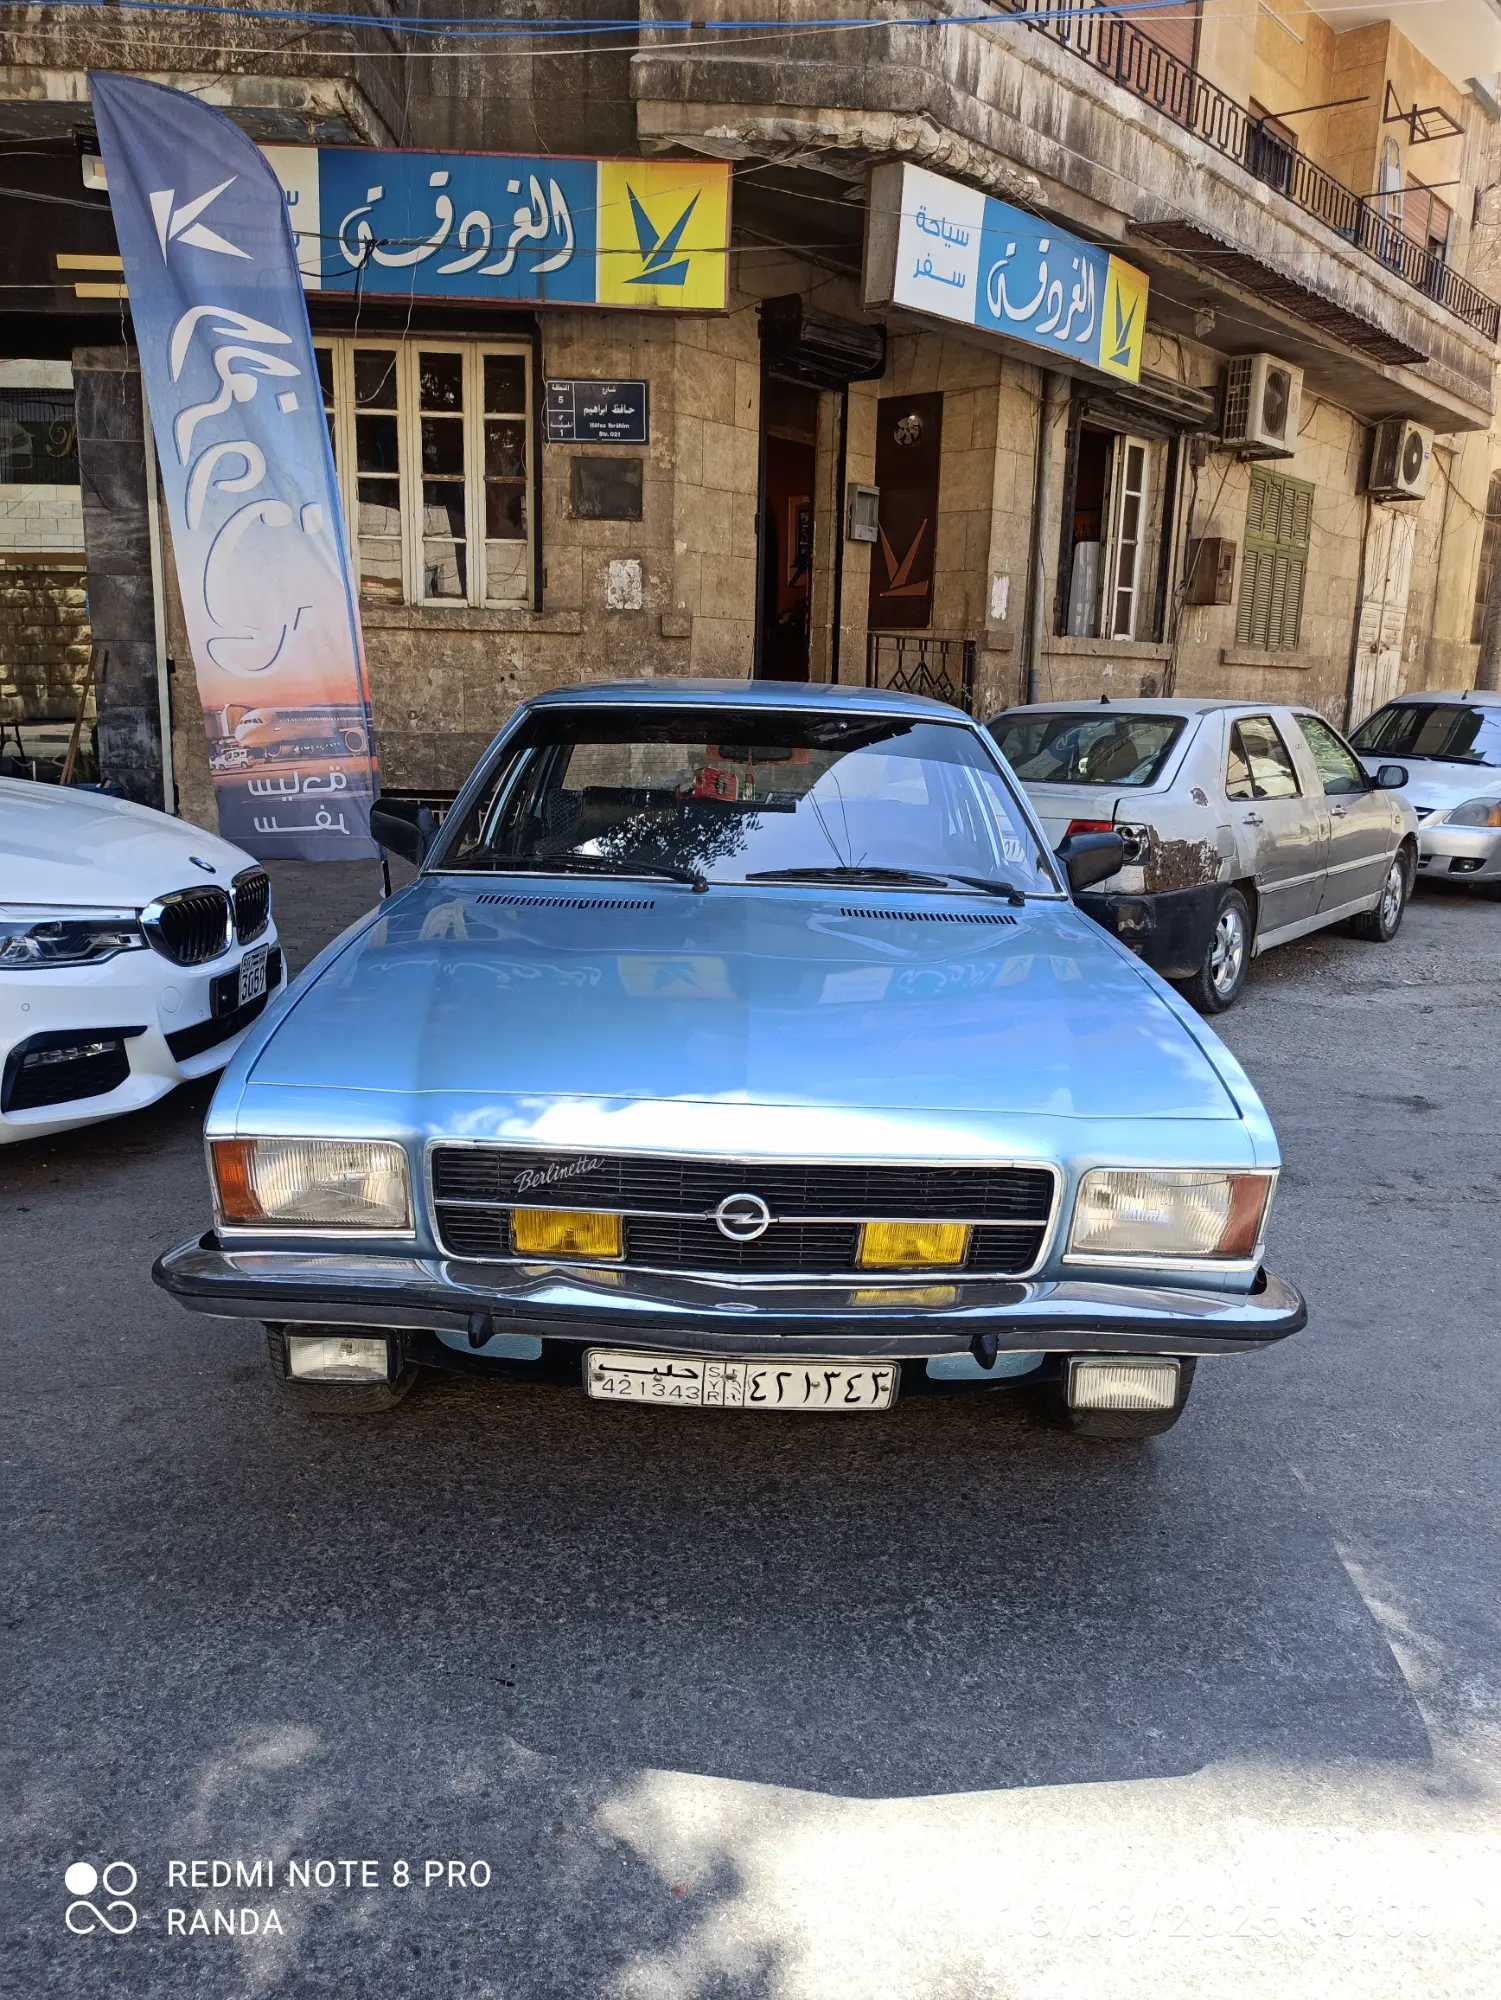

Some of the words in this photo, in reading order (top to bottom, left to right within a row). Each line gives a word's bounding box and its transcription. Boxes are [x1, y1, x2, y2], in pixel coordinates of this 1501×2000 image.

[915, 205, 970, 249] سياحة
[912, 253, 967, 289] سفر
[558, 395, 564, 404] 5
[601, 385, 617, 396] شارع
[611, 403, 636, 415] حافظ
[559, 429, 564, 437] 1
[513, 1155, 605, 1194] Berlinetta
[598, 1361, 700, 1380] حلب
[601, 1378, 700, 1400] 421343
[707, 1366, 721, 1402] SYR
[749, 1370, 890, 1404] ٤٢١٣٤٣
